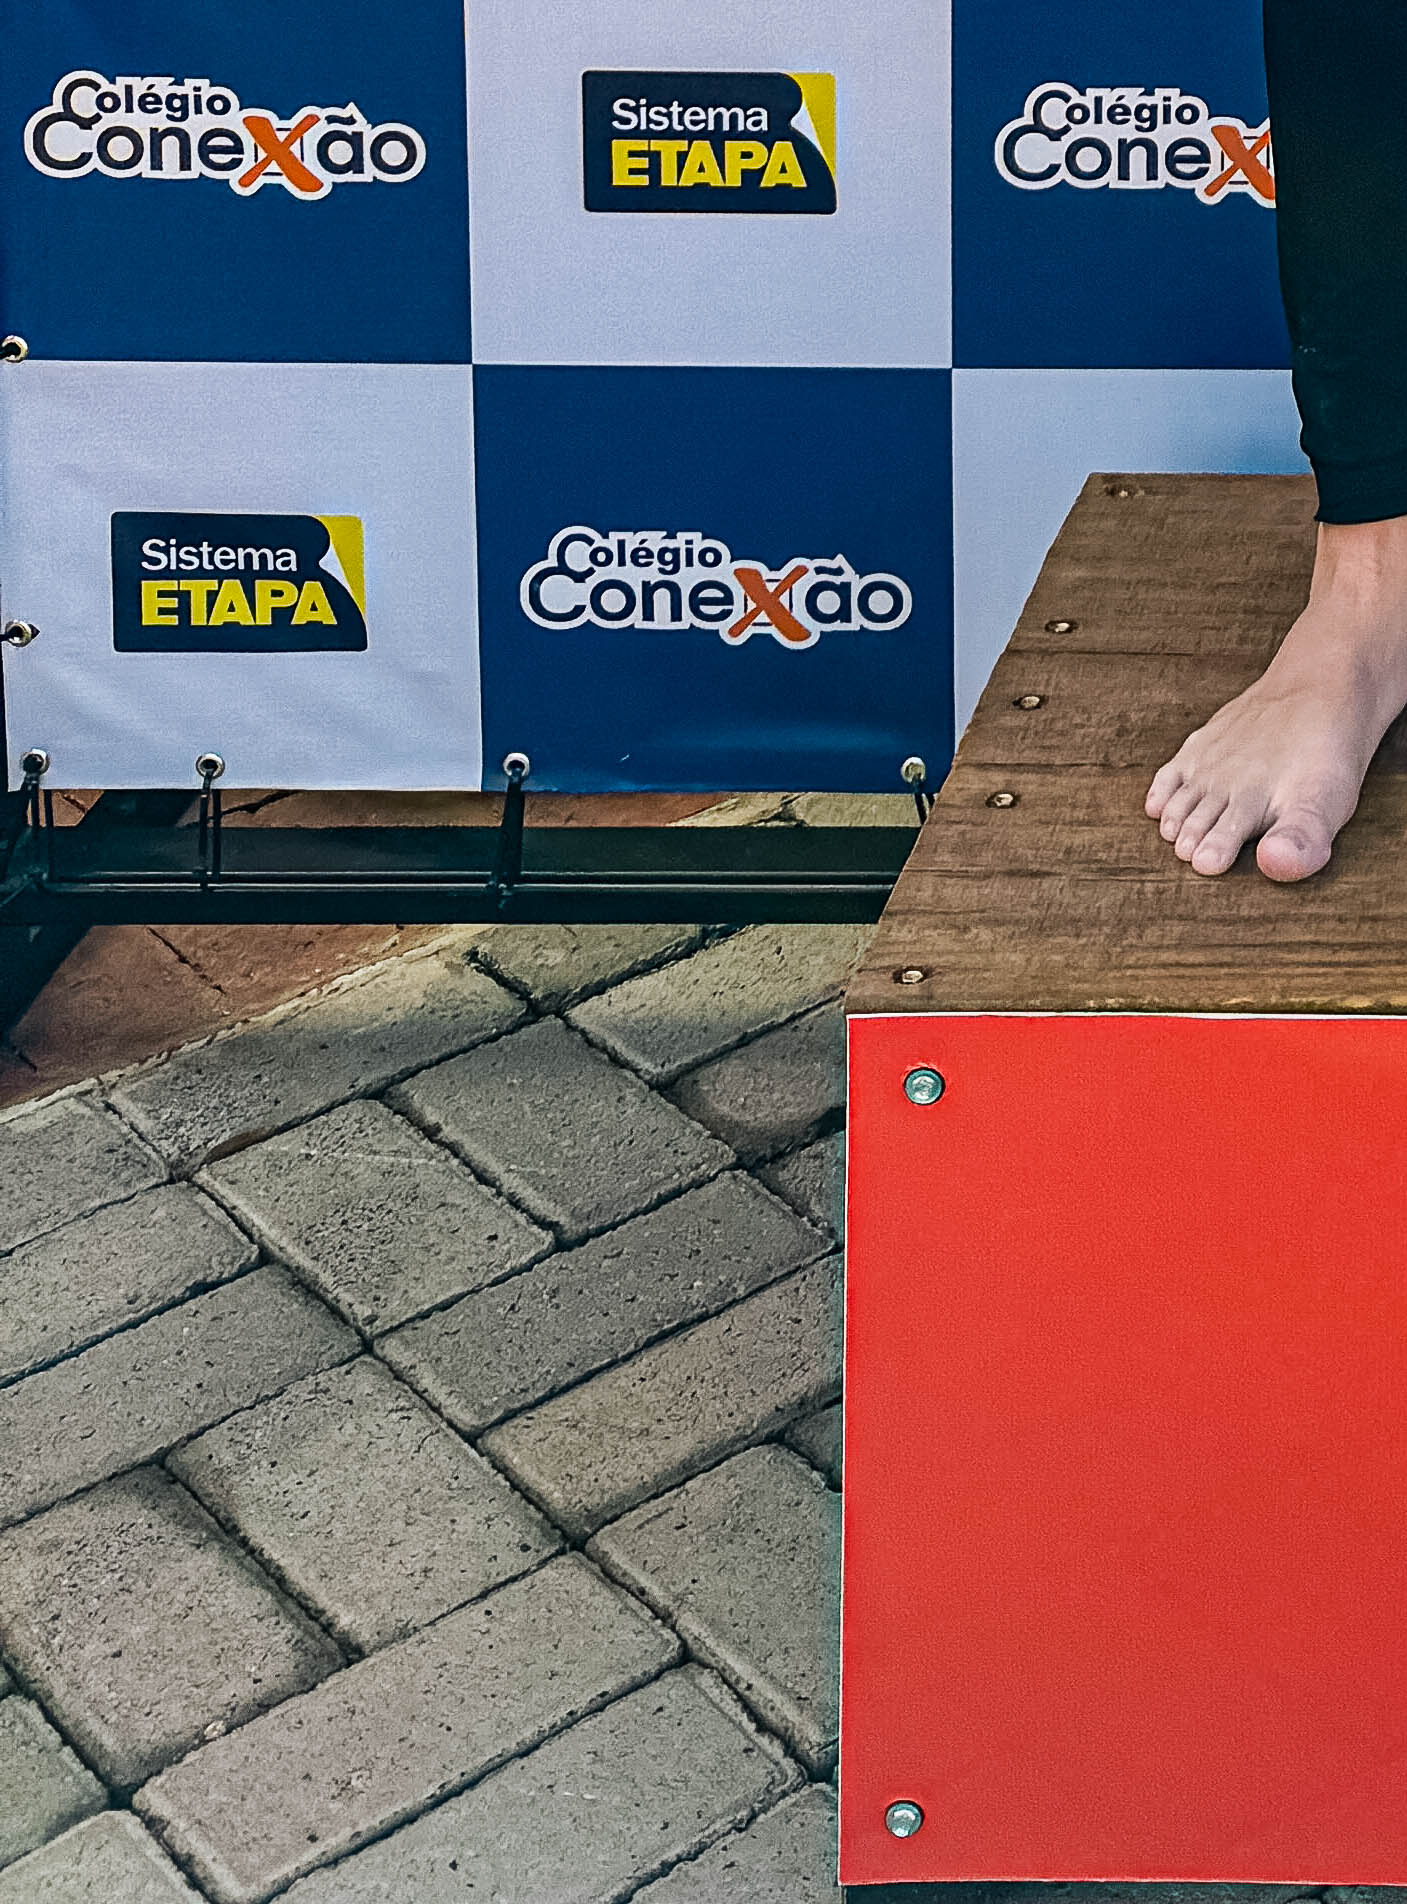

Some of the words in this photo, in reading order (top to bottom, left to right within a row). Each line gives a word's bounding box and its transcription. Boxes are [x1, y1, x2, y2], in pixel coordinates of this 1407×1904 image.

[62, 75, 233, 124] Colégio
[612, 99, 770, 136] Sistema
[1035, 87, 1201, 133] Colégio
[611, 140, 806, 188] ETAPA
[143, 538, 297, 576] Sistema
[557, 530, 724, 576] Colégio
[141, 581, 337, 626] ETAPA
